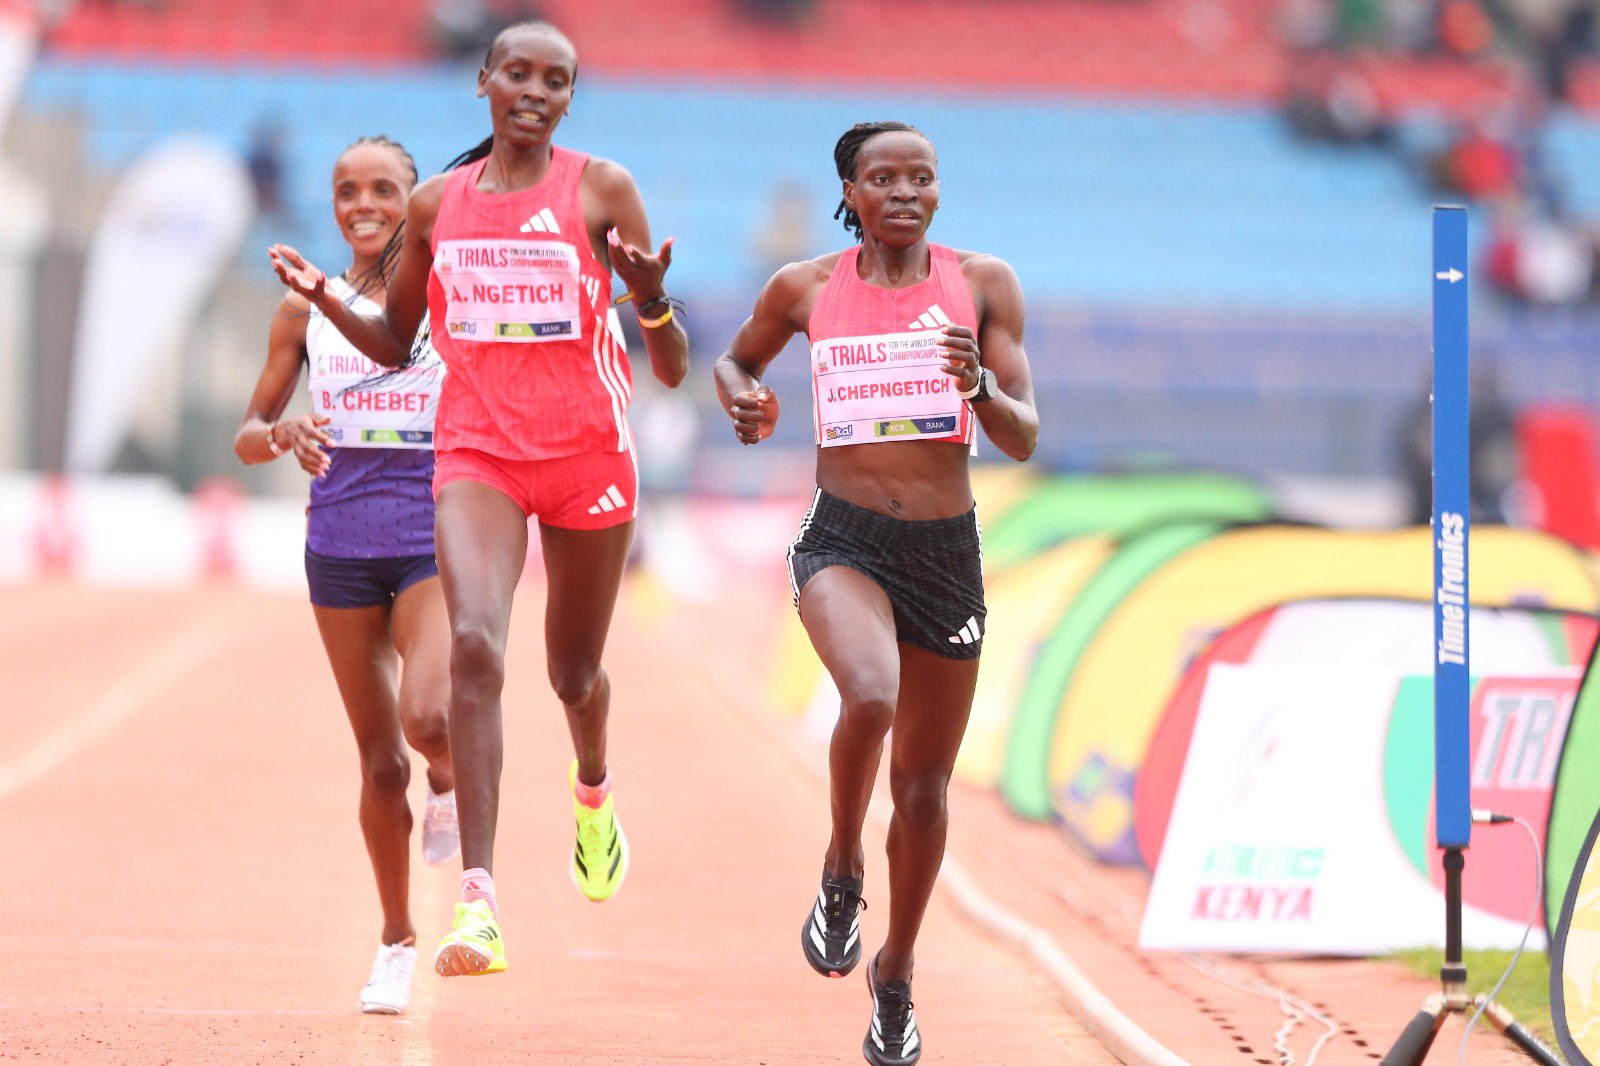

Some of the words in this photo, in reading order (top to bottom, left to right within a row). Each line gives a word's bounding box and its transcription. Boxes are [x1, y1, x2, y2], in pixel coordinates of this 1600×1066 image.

[456, 248, 508, 268] TRIALS
[452, 285, 467, 302] A.
[473, 284, 563, 304] NGETICH
[541, 325, 560, 334] BANK
[889, 341, 899, 349] FOR
[900, 340, 909, 348] THE
[910, 339, 928, 348] WORLD
[329, 354, 378, 376] TRIALS
[830, 343, 887, 367] TRIALS
[890, 348, 938, 362] CHAMPIONSHIPS
[321, 390, 336, 410] B.
[342, 390, 430, 412] CHEBET
[889, 423, 905, 432] KCB
[925, 421, 945, 430] BANK
[1437, 511, 1465, 666] TimeTronics
[1190, 885, 1313, 921] KENYA
